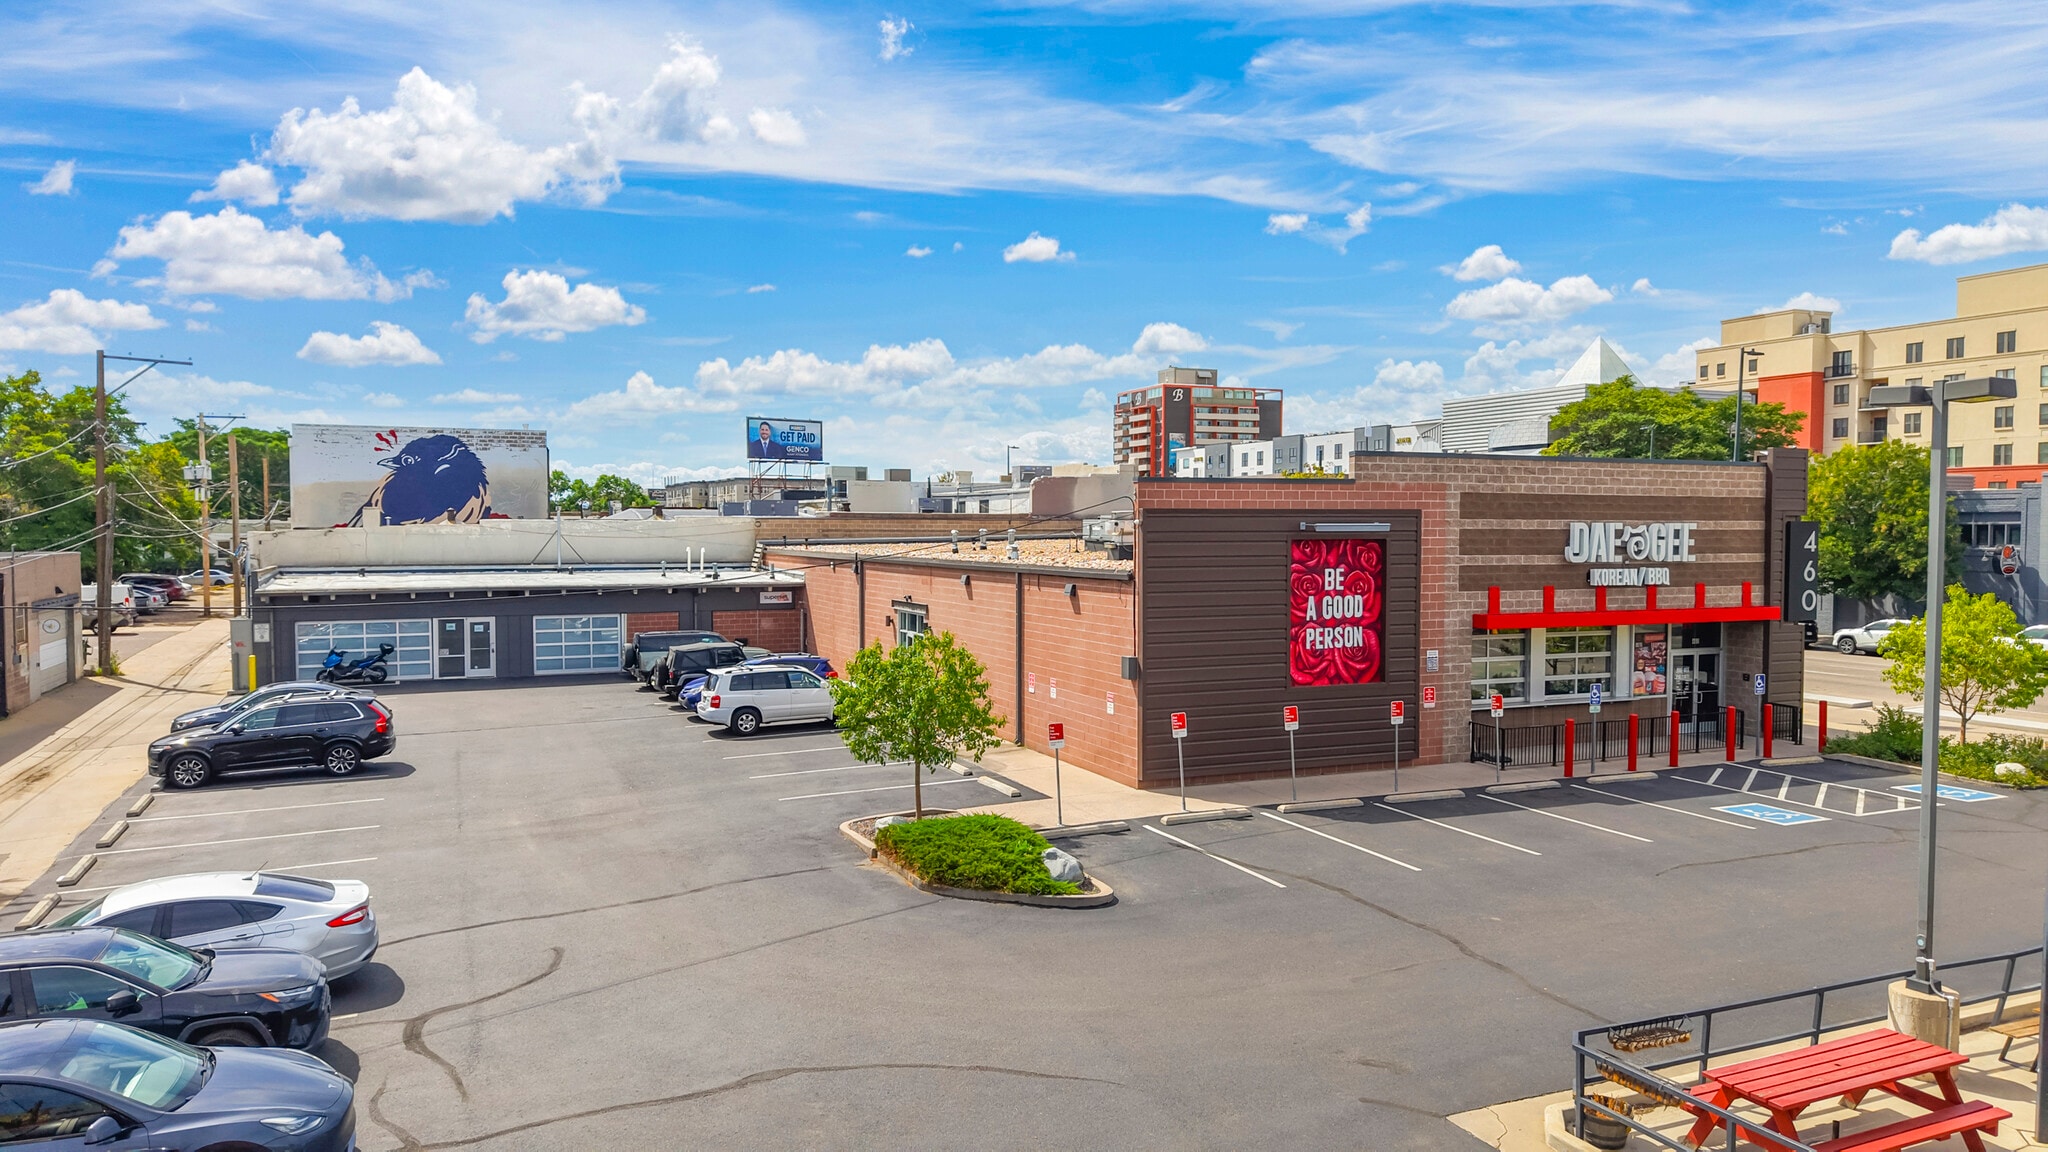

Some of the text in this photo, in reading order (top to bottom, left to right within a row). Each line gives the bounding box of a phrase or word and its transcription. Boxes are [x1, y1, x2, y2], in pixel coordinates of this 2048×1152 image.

[1172, 388, 1184, 402] B
[780, 431, 816, 443] GET PAID
[786, 445, 809, 453] GENCO
[1565, 522, 1698, 563] DAE GEE
[1324, 568, 1345, 591] BE
[1801, 530, 1817, 611] 460
[1306, 594, 1363, 621] A GOOD
[1305, 626, 1363, 650] PERSON
